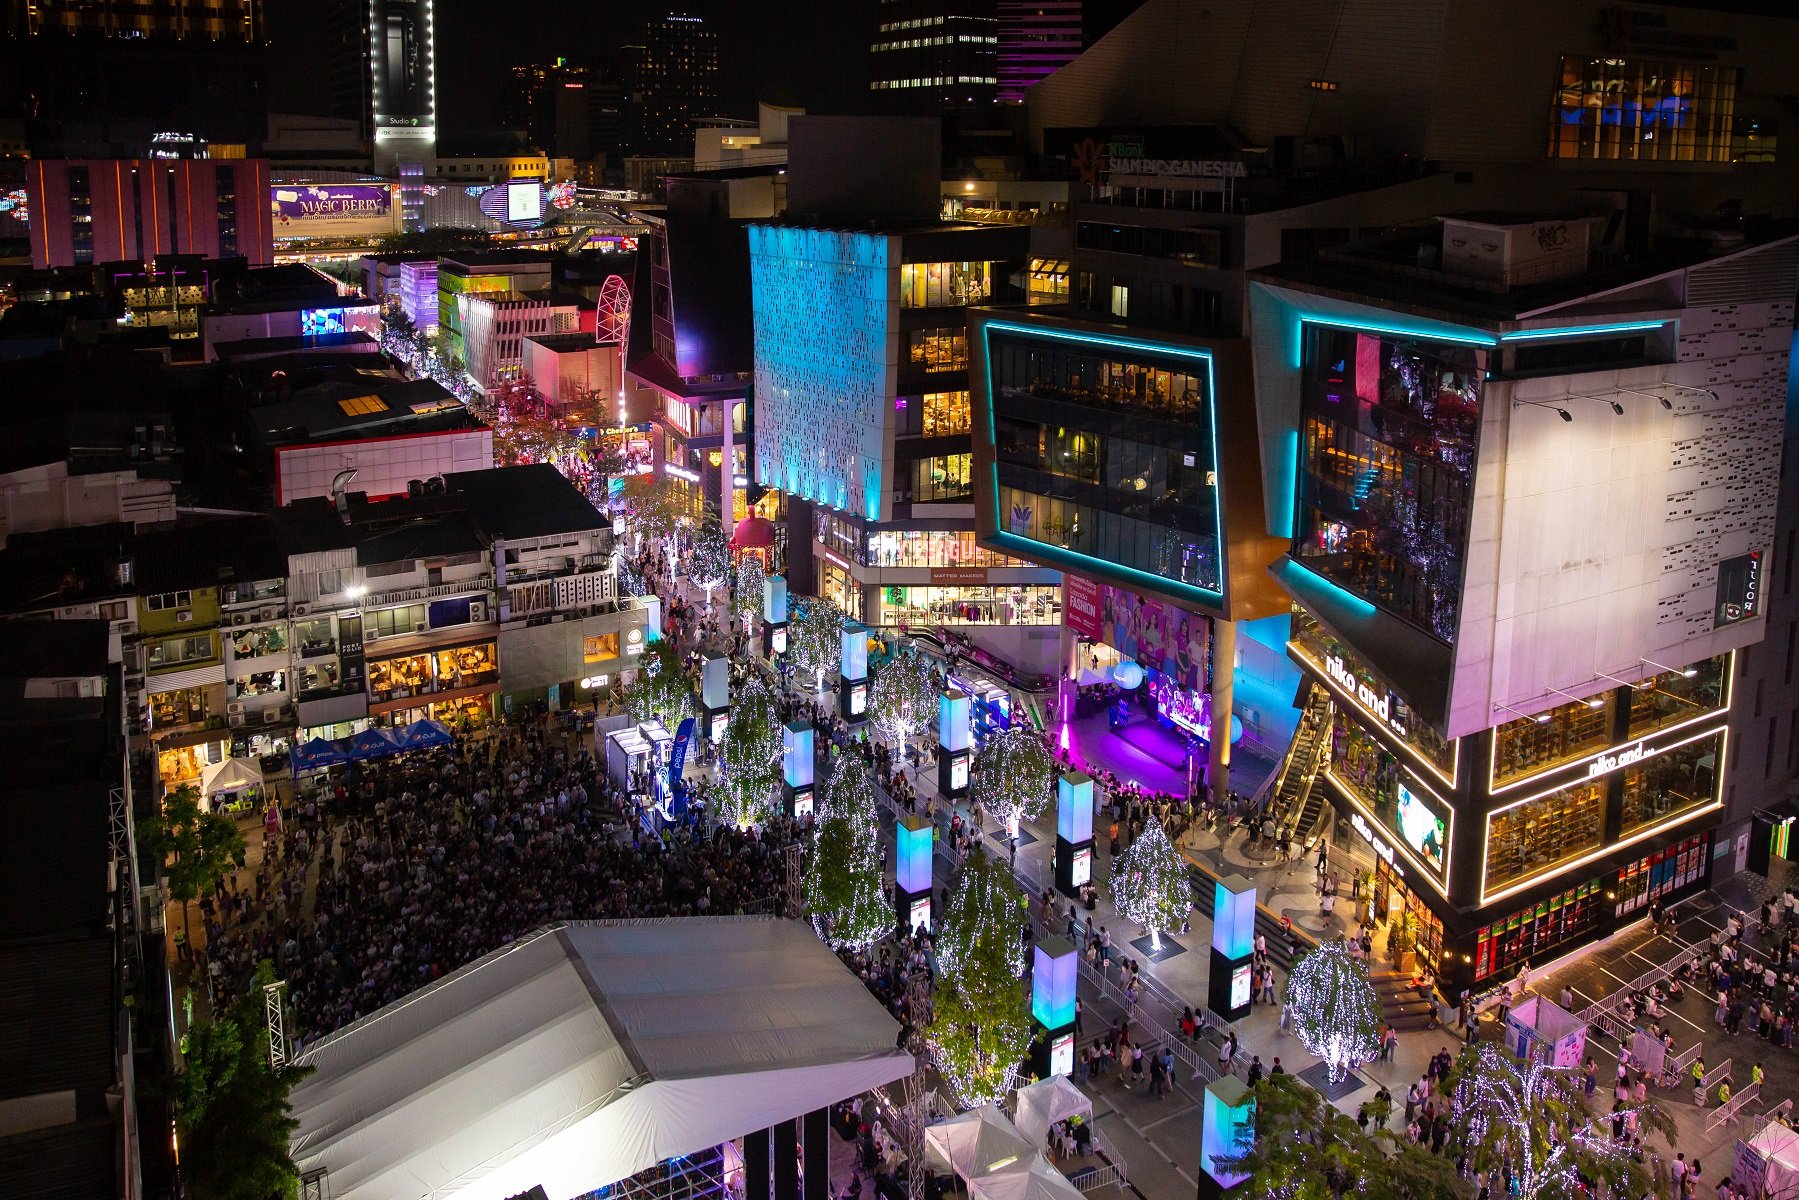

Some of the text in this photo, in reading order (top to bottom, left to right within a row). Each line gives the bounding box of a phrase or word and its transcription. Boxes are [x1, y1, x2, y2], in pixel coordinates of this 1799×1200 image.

[300, 199, 382, 213] MAGIC BERRY
[1069, 595, 1096, 618] FASHION
[1326, 655, 1356, 693] niko
[316, 751, 334, 759] pepsi
[674, 746, 684, 769] pepsi
[1589, 756, 1616, 777] niko
[1351, 813, 1373, 842] niko
